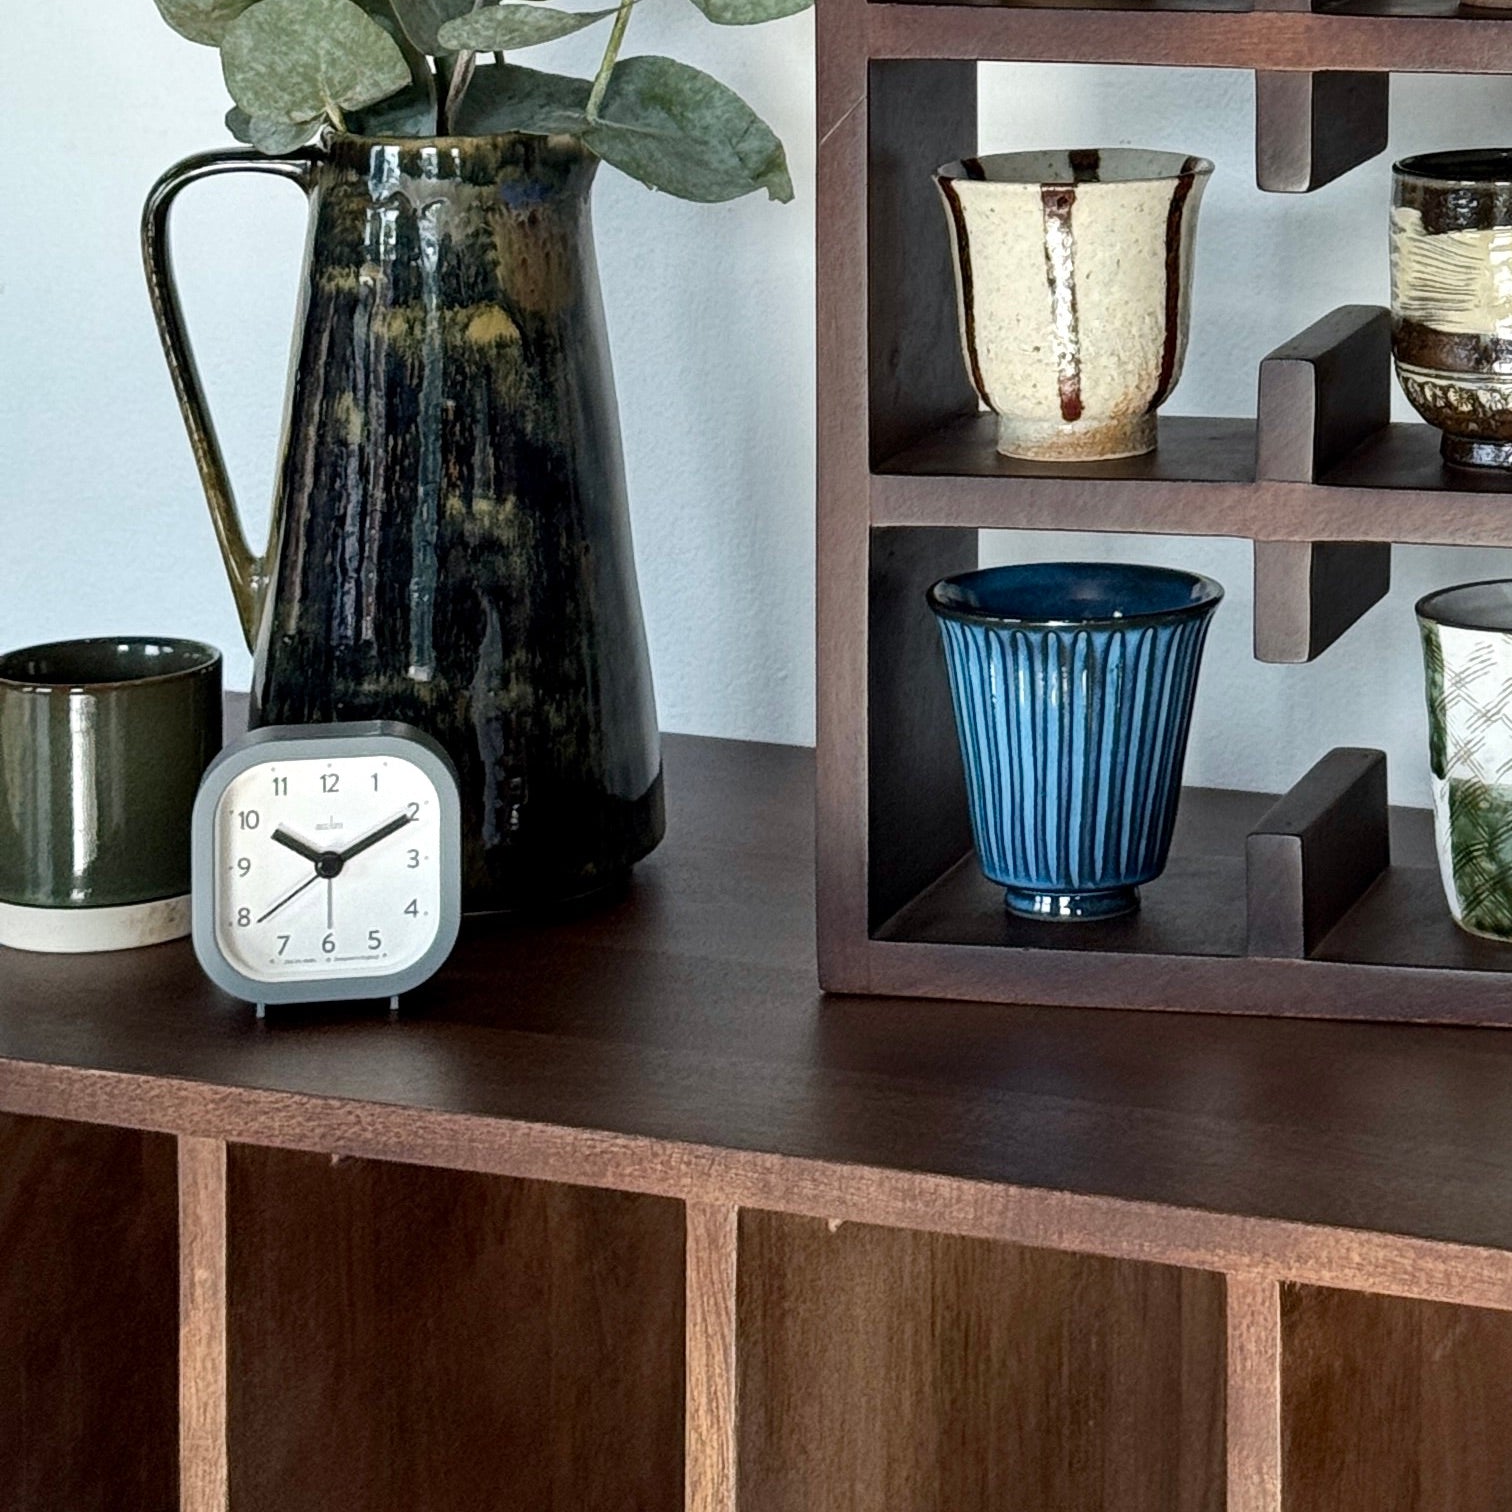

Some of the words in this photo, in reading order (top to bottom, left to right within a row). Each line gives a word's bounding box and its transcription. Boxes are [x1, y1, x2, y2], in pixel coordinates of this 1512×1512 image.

[272, 776, 288, 796] 11
[319, 773, 340, 793] 12
[370, 772, 379, 792] 1
[238, 810, 260, 830] 10
[407, 802, 420, 822] 2
[237, 857, 251, 877] 9
[406, 849, 420, 869] 3
[237, 907, 251, 928] 8
[403, 899, 418, 918] 4
[276, 935, 291, 956] 7
[321, 932, 336, 954] 6
[367, 929, 382, 950] 5
